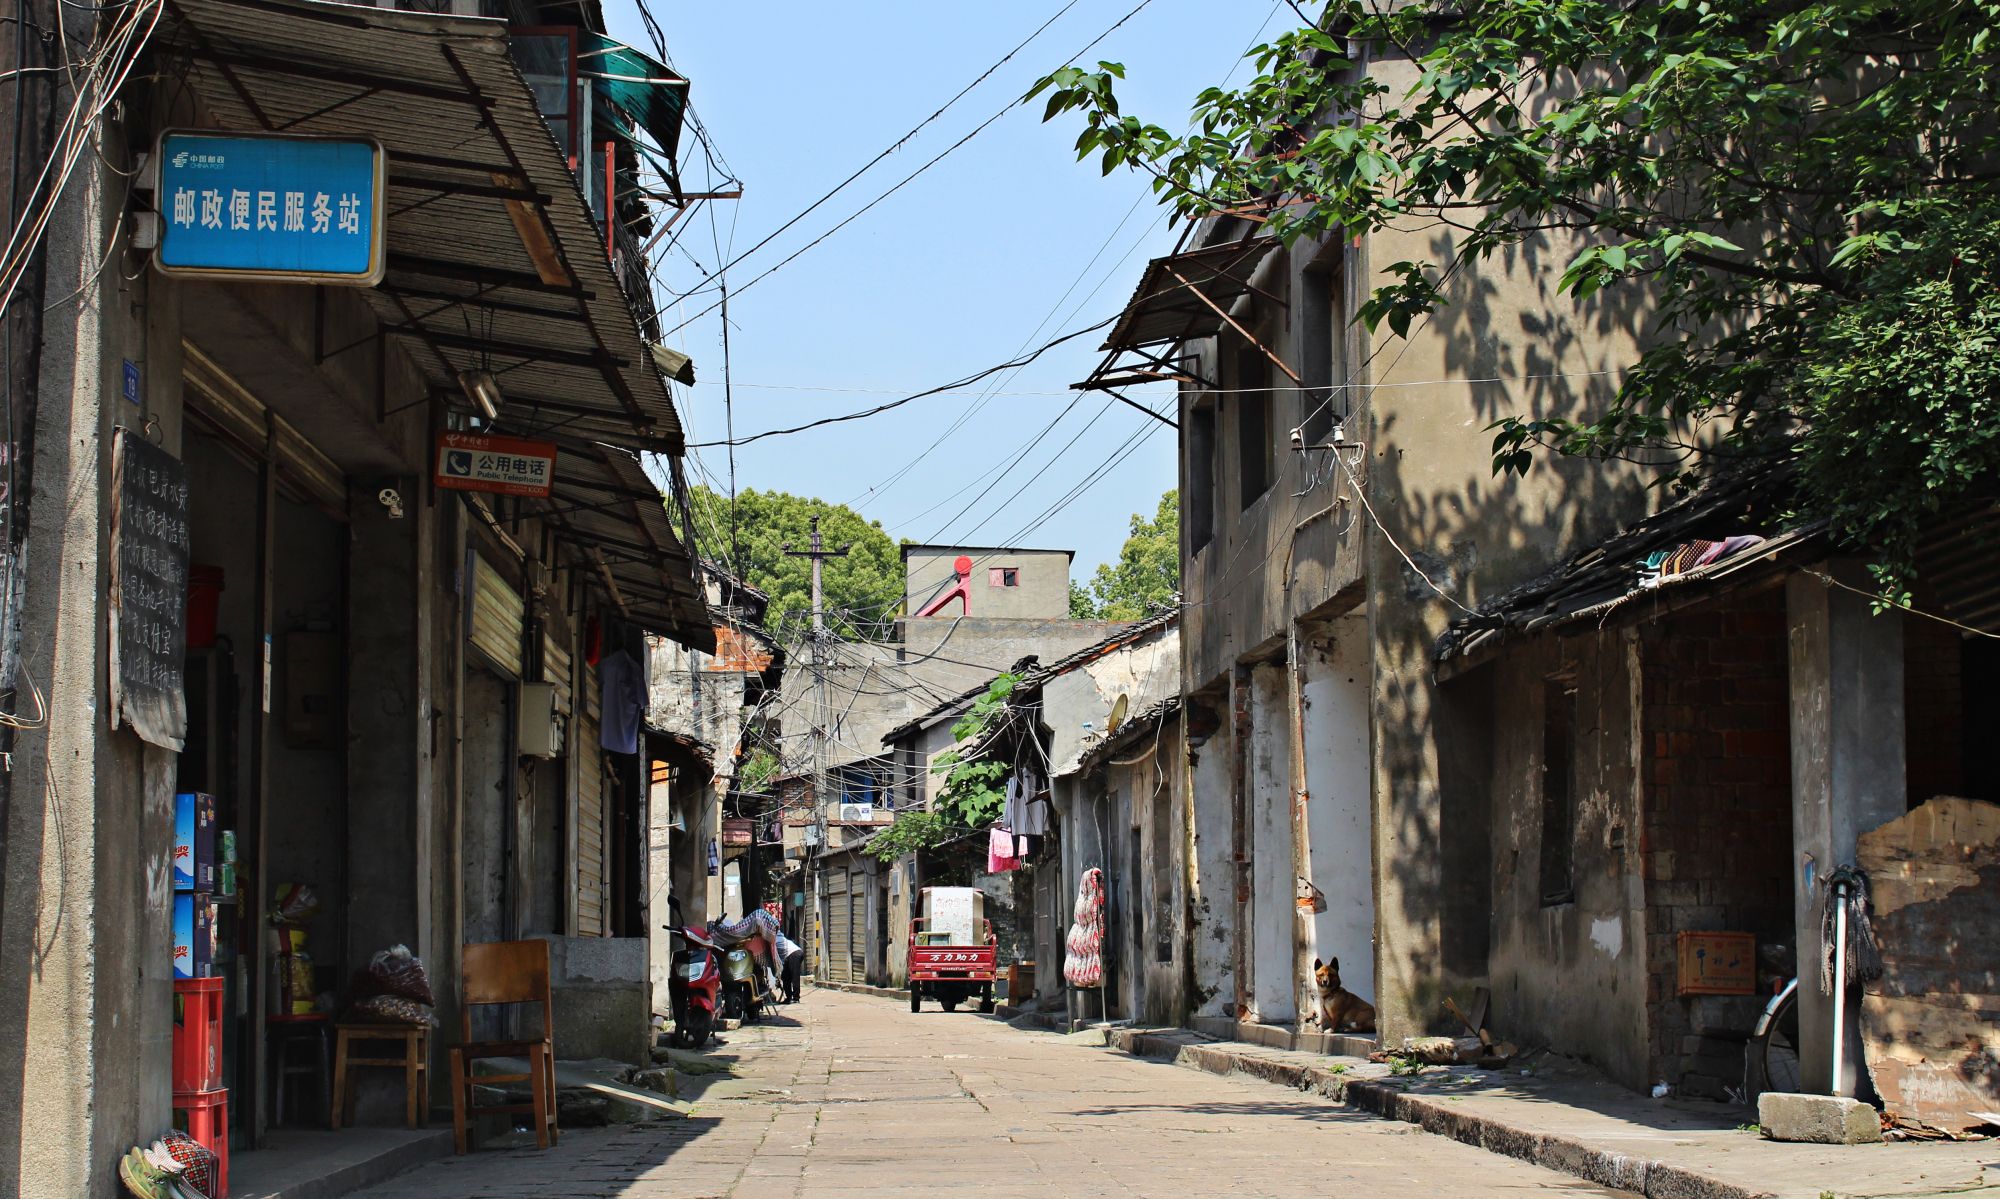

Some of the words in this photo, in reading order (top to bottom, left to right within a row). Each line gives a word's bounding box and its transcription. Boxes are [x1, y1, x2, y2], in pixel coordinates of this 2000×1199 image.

[190, 154, 225, 164] 中国邮政
[174, 186, 360, 235] 邮政便民服务站
[127, 376, 136, 397] 19
[479, 455, 545, 476] 公用电话
[477, 470, 501, 480] Public
[503, 473, 544, 484] Telephone
[930, 953, 979, 962] 万力助力
